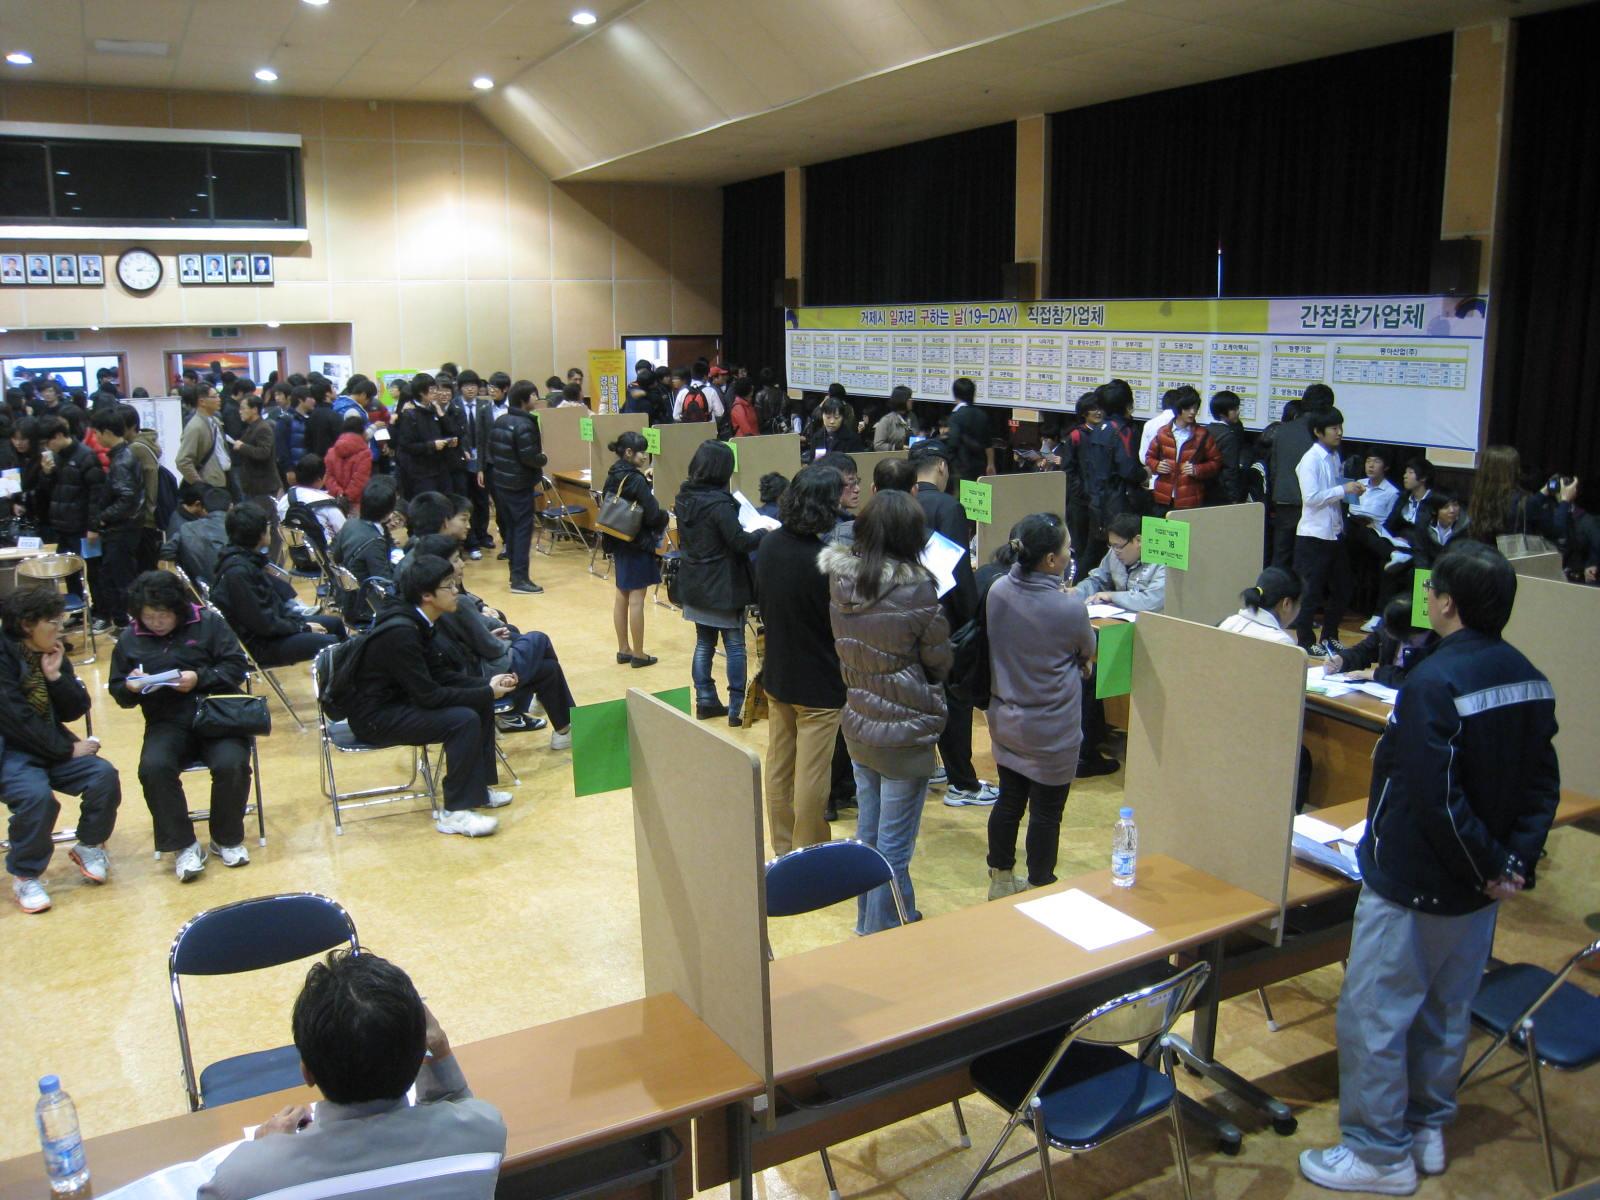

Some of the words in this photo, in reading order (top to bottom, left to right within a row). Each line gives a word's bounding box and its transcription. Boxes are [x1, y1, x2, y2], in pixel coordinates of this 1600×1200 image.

[861, 309, 886, 326] 거제시
[889, 309, 916, 326] 일자리
[920, 308, 949, 326] 구하는
[953, 305, 1018, 326] 날(19-DAY)
[1027, 305, 1104, 326] 직접참가업체
[1300, 303, 1425, 330] 간접참가업체
